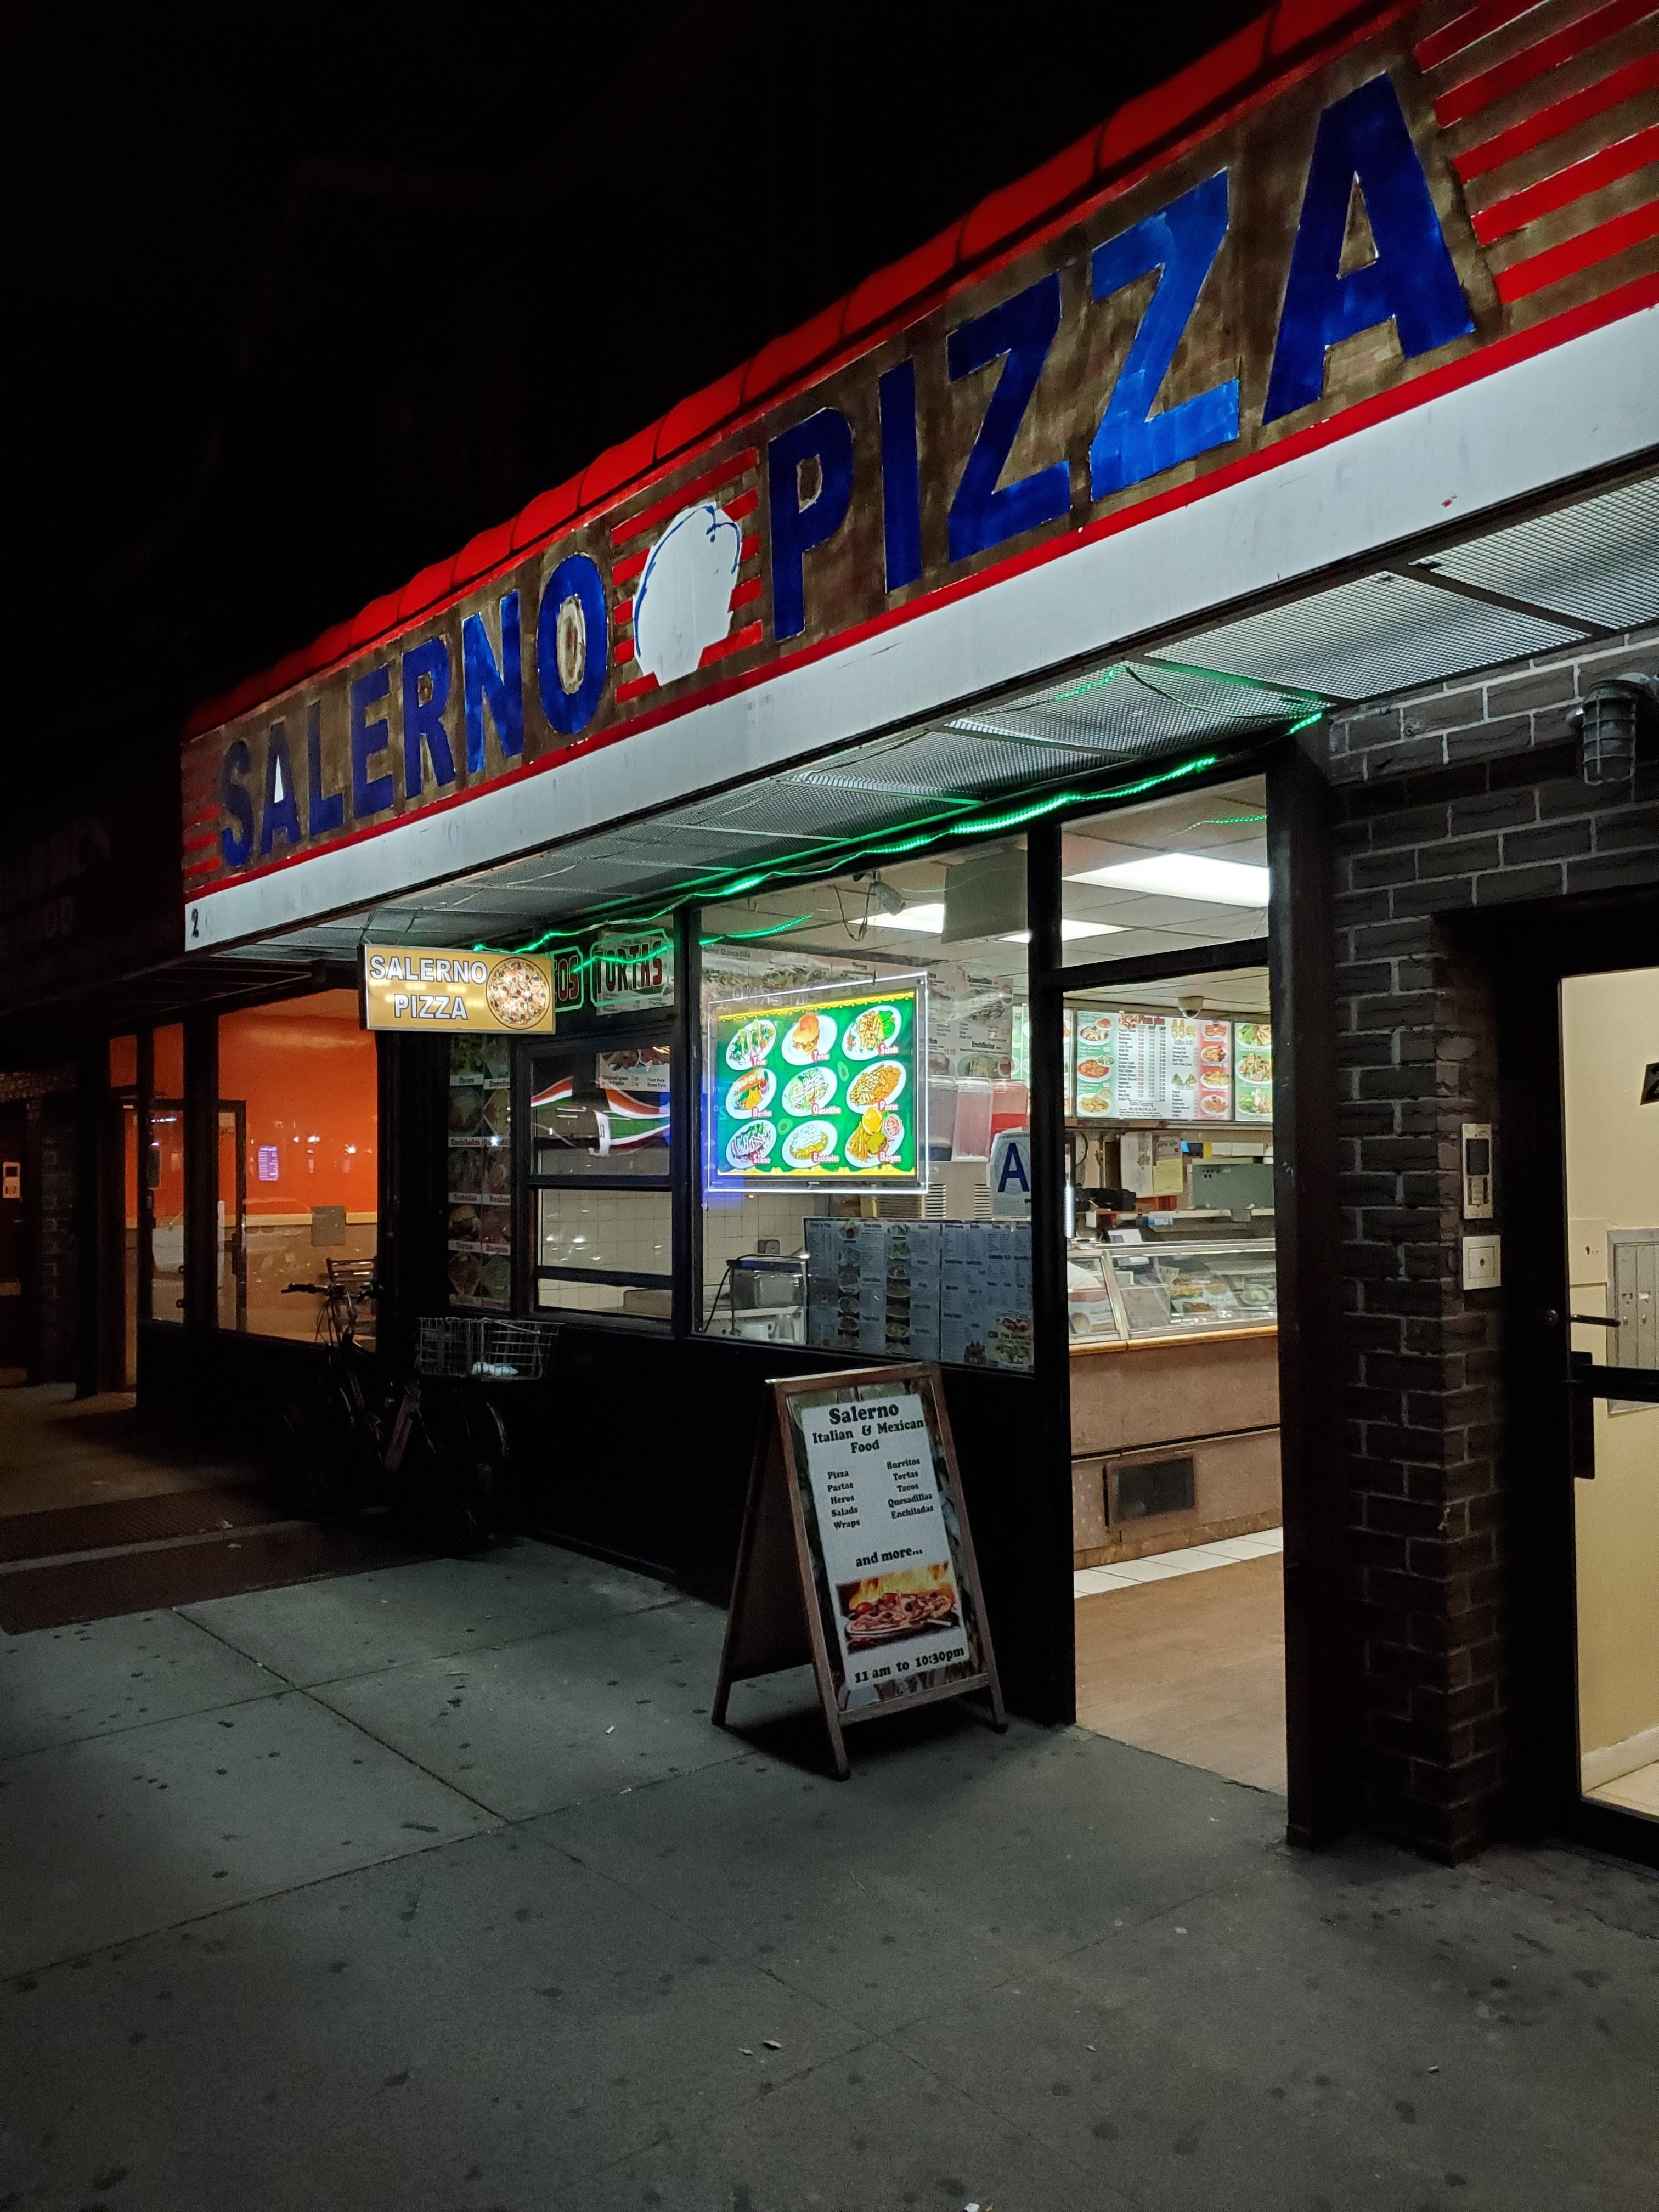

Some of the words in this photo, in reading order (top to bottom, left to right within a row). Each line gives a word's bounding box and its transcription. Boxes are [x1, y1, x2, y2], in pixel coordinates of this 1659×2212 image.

[221, 551, 607, 868] SALERNO
[768, 70, 1477, 642] PIZZA
[370, 955, 487, 984] SALERNO
[592, 940, 663, 994] TORTAS
[394, 994, 468, 1020] PIZZA
[997, 1143, 1030, 1192] A
[829, 1403, 899, 1425] Salerno
[812, 1429, 854, 1444] Italian
[861, 1425, 872, 1436] &
[878, 1419, 924, 1435] Mexican
[851, 1439, 880, 1454] Food
[887, 1457, 921, 1470] Burritos
[827, 1470, 850, 1480] Pizza
[893, 1470, 919, 1481] Tortas
[827, 1481, 854, 1493] Pastas
[897, 1482, 919, 1493] Tacos
[830, 1493, 855, 1505] Heros
[888, 1492, 933, 1508] Quesadillas
[831, 1506, 859, 1517] Salads
[891, 1505, 934, 1520] Enchiladas
[833, 1519, 860, 1531] Wraps
[855, 1553, 879, 1567] and
[882, 1547, 923, 1562] more...
[854, 1672, 868, 1684] 11
[871, 1665, 891, 1677] am
[896, 1660, 910, 1672] to
[915, 1646, 964, 1669] 10:30pm
